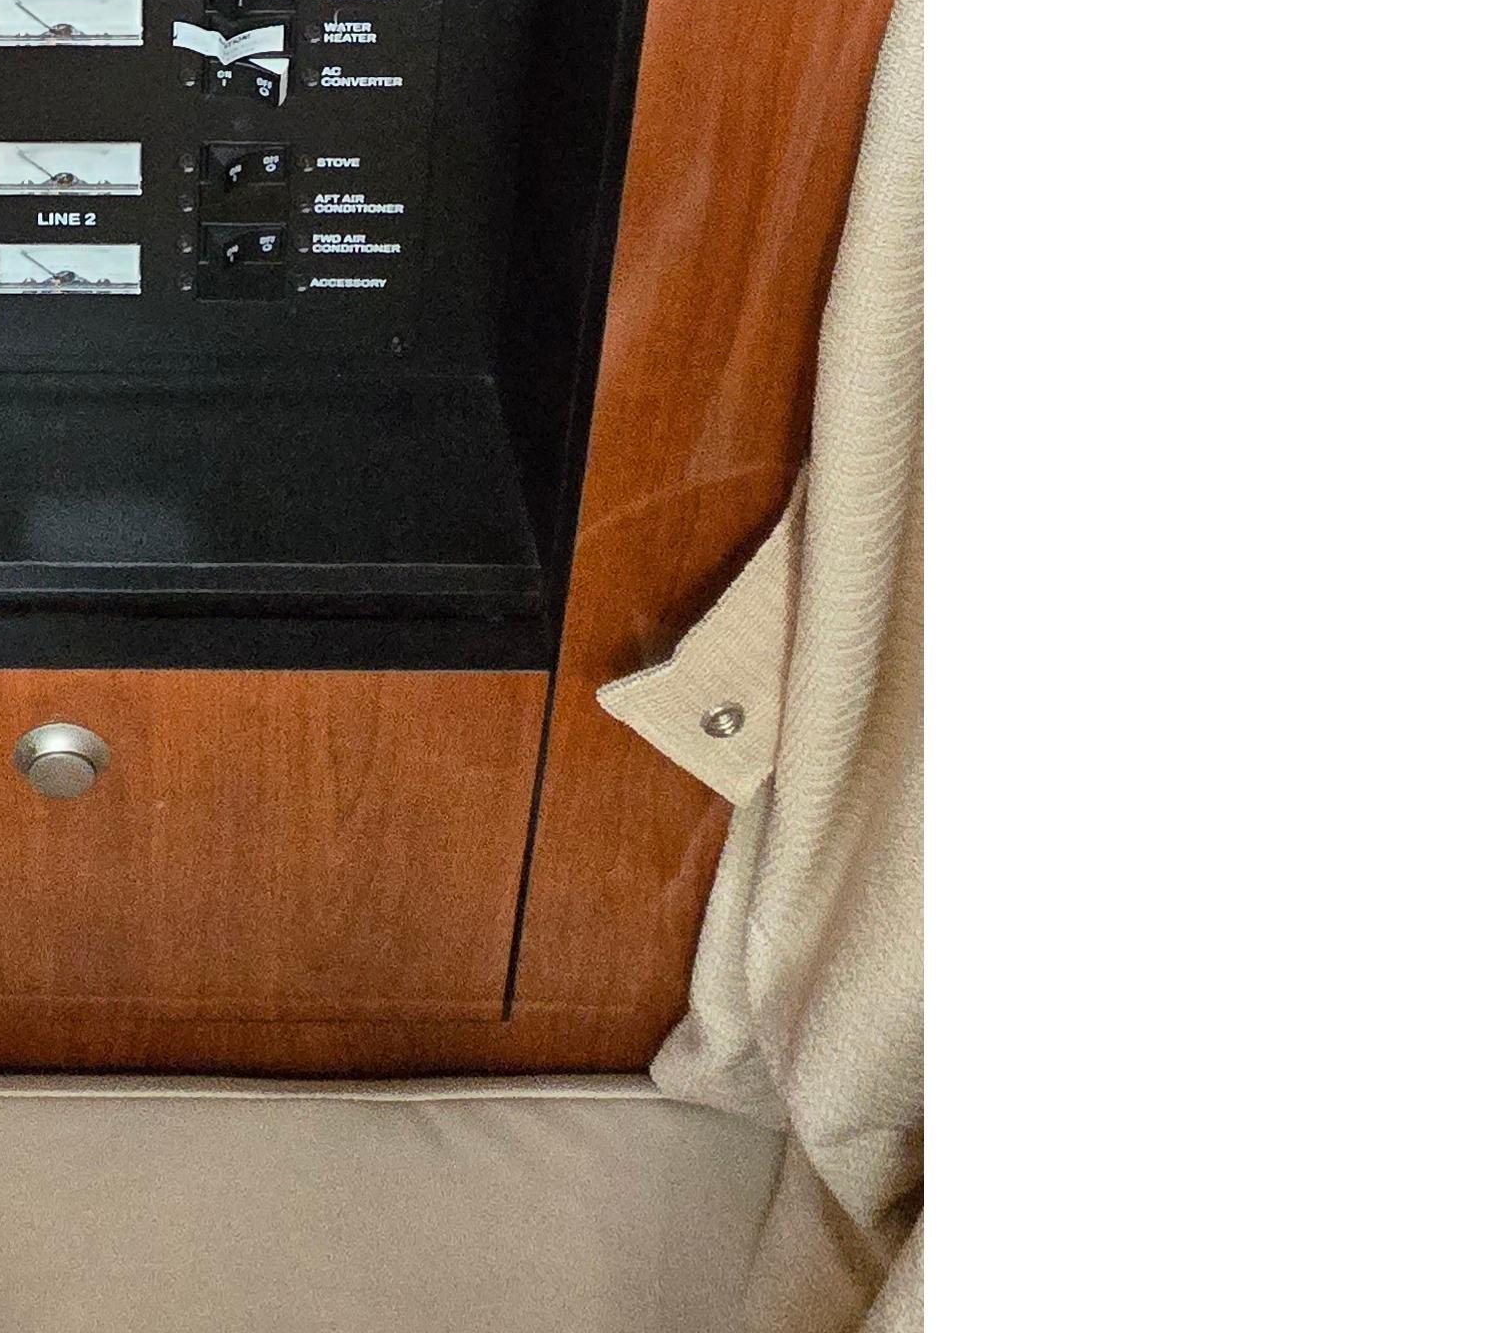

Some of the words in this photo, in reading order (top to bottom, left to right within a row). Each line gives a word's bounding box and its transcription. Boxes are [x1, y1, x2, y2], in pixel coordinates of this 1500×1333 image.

[324, 23, 372, 33] WATER
[324, 33, 376, 43] HEATER
[321, 67, 341, 76] AC
[321, 77, 403, 87] CONVERTER
[317, 158, 360, 168] STOVE
[315, 194, 341, 203] AFT
[342, 194, 365, 203] AIR
[314, 204, 404, 214] CONDITIONER
[38, 212, 80, 226] LINE
[85, 212, 96, 226] 2
[313, 234, 341, 244] FWD
[343, 234, 366, 243] AIR
[312, 244, 401, 254] CONDITIONER
[311, 278, 386, 288] ACCESSORY
